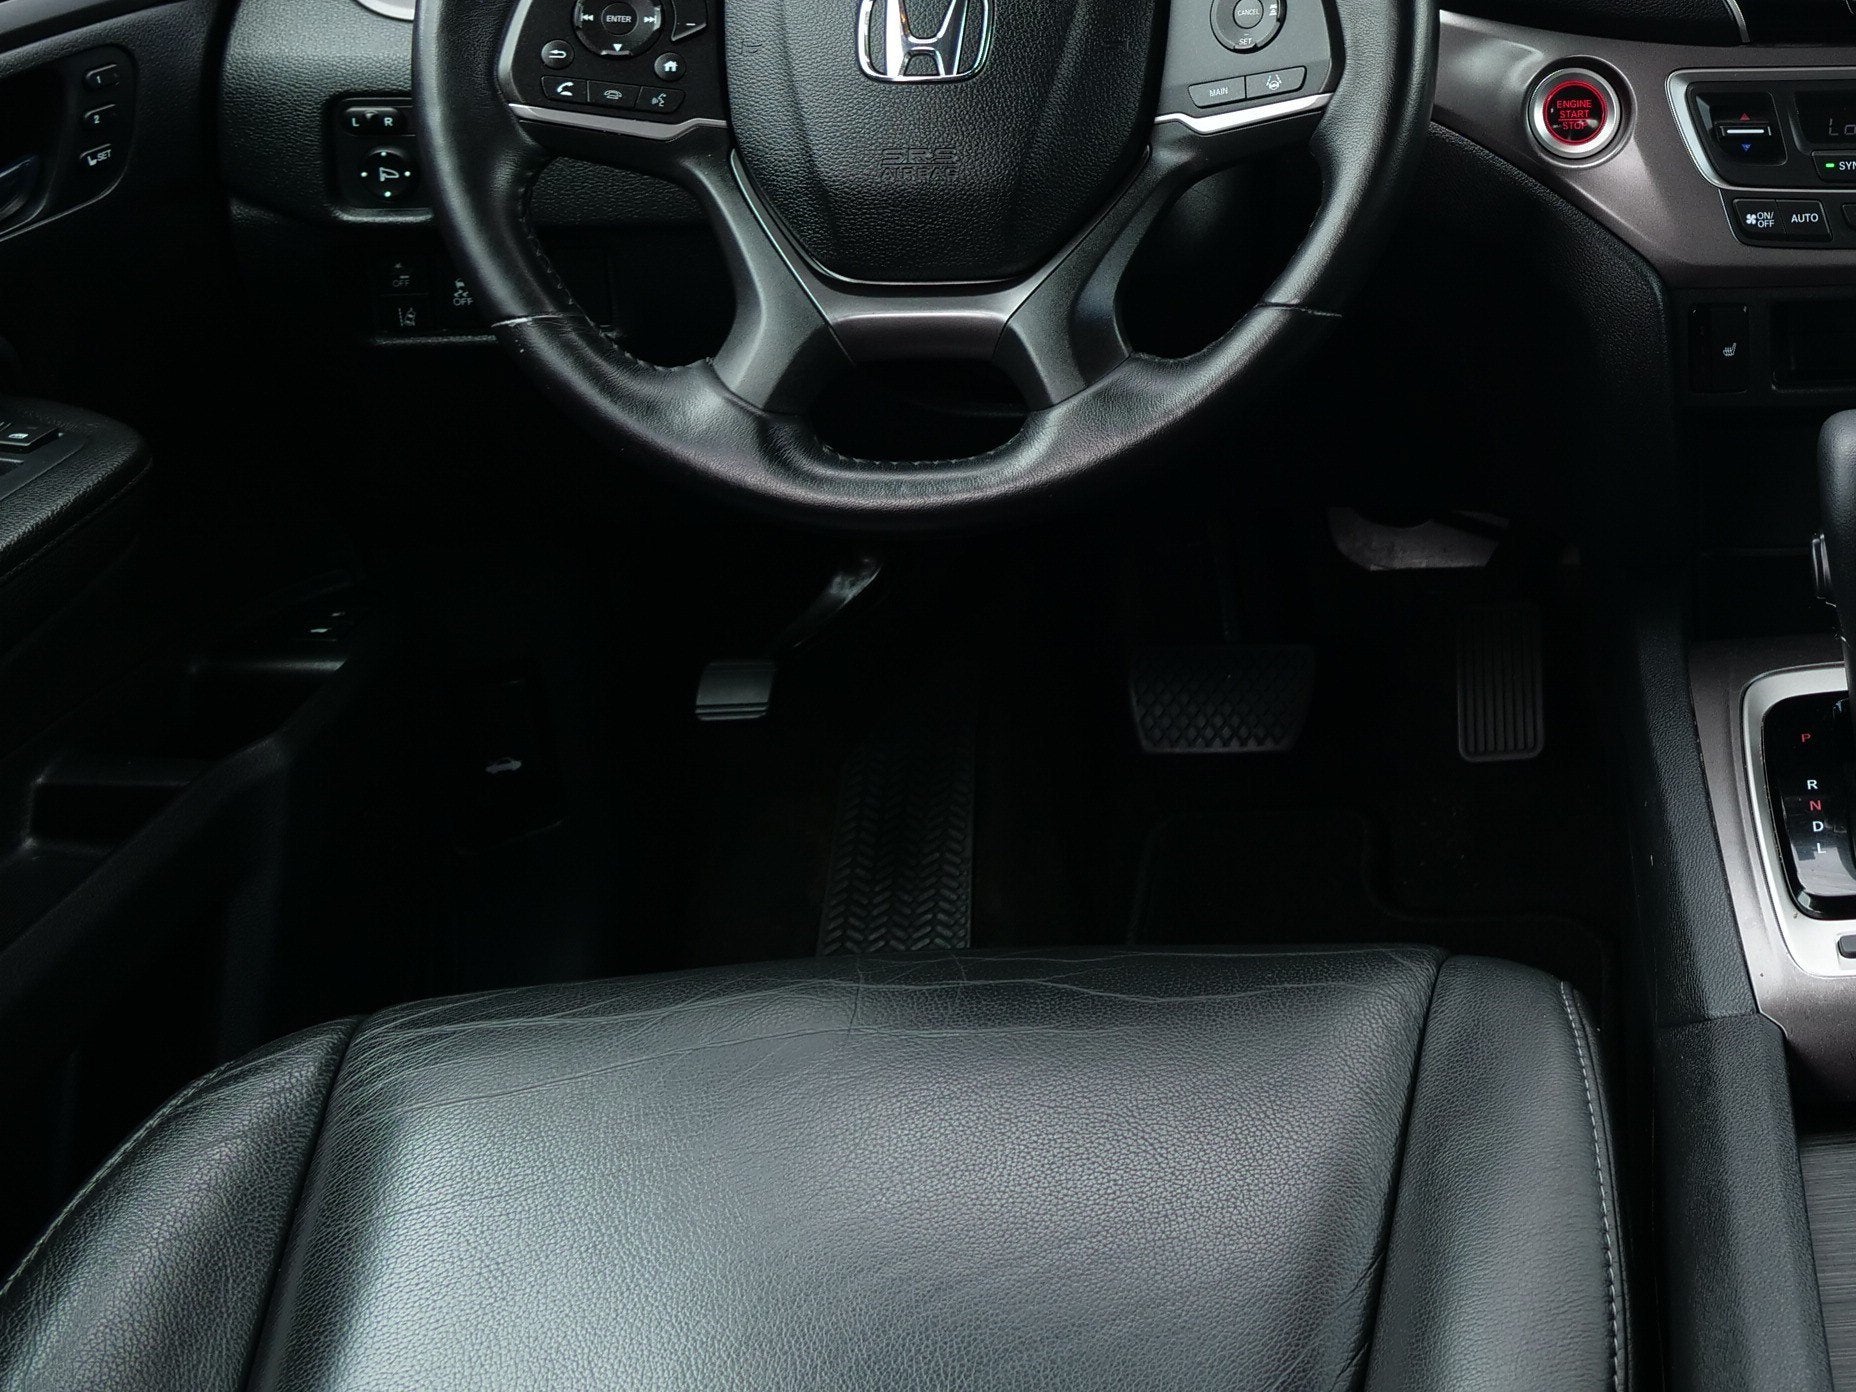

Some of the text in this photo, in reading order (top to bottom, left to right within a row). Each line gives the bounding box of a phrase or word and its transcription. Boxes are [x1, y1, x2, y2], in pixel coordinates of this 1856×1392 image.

[1237, 8, 1260, 17] CANCEL
[606, 14, 632, 24] ENTER
[1239, 37, 1254, 46] SET
[1208, 87, 1230, 97] MAIN
[1556, 99, 1592, 108] ENGINE
[1559, 110, 1590, 119] START
[352, 118, 359, 127] L
[384, 117, 394, 127] R
[1562, 121, 1589, 130] STOP
[97, 149, 112, 161] SET
[881, 147, 957, 165] SRS
[1756, 211, 1775, 220] ON/
[1790, 213, 1819, 223] AUTO
[1757, 220, 1775, 228] OFF
[392, 279, 410, 288] OFF
[452, 297, 474, 306] OFF
[1801, 733, 1811, 743] P
[1807, 779, 1818, 790] R
[1809, 800, 1822, 810] N
[1812, 821, 1825, 832] D
[1816, 842, 1827, 854] L
